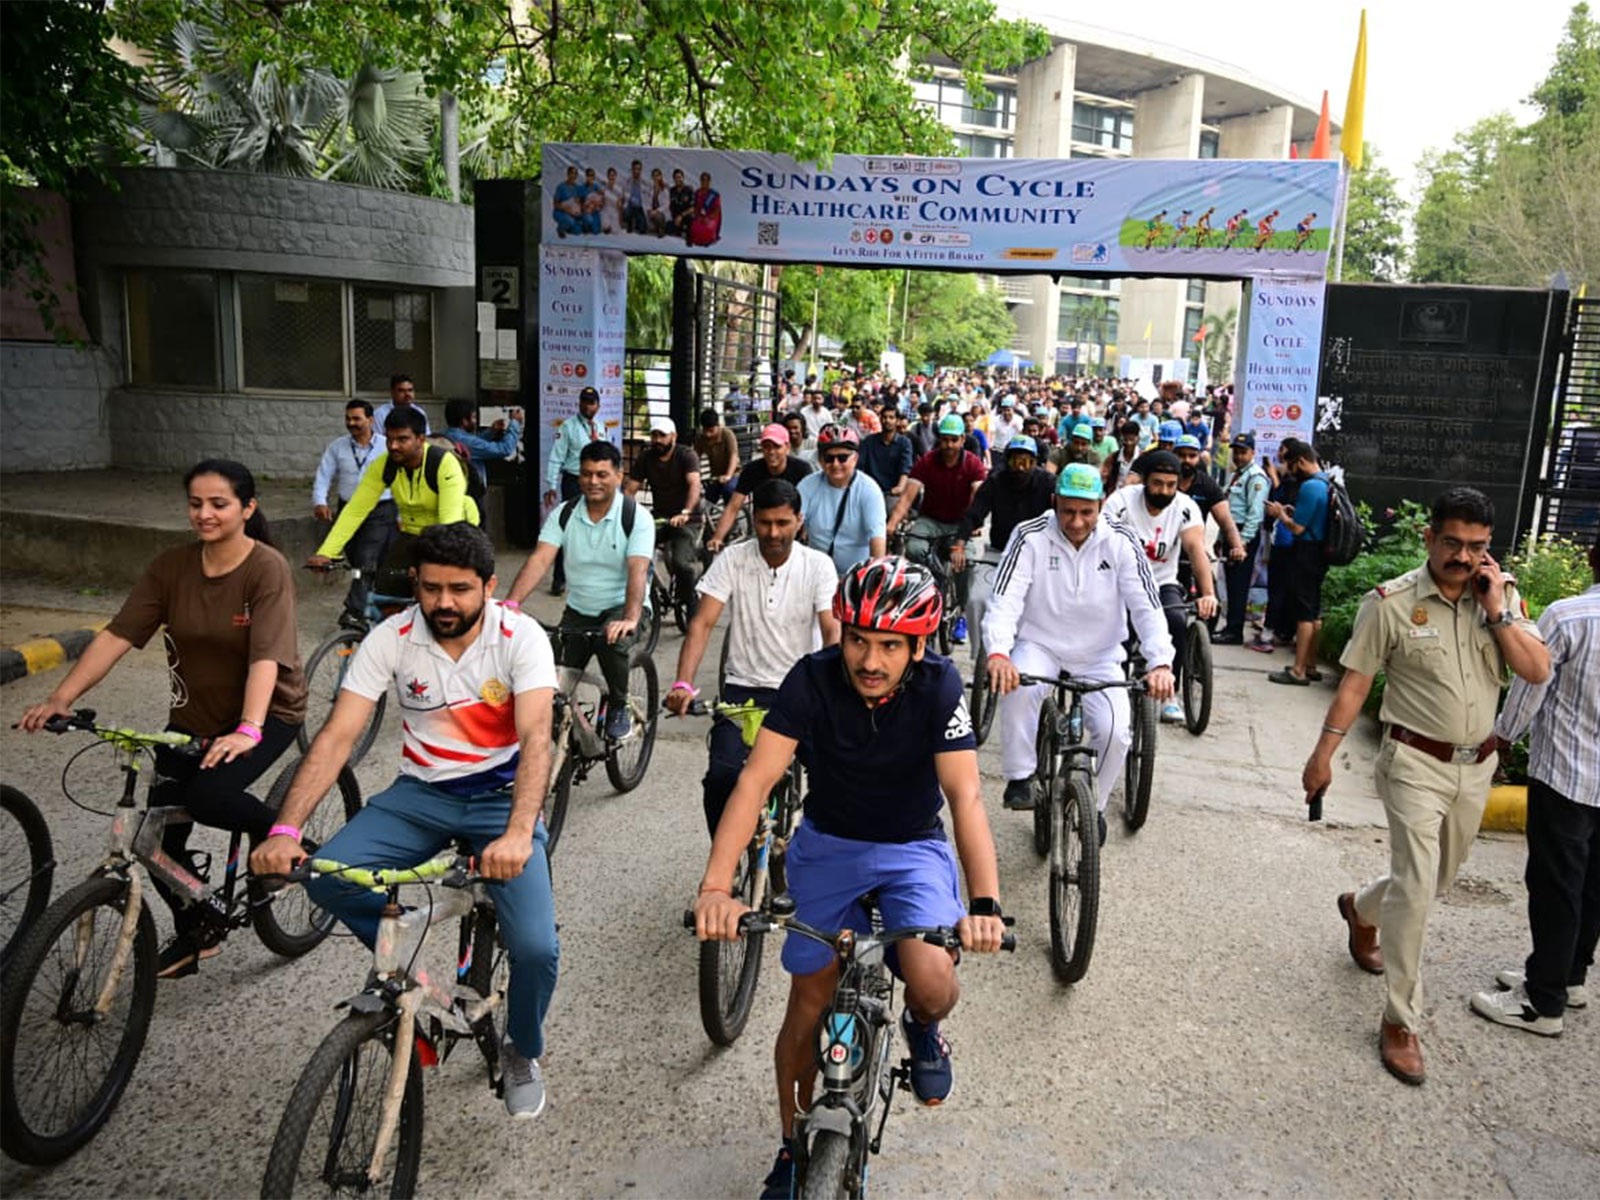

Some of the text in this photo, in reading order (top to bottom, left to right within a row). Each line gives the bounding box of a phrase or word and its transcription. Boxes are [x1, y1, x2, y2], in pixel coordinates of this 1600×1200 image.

[741, 166, 1095, 198] SUNDAYS ON CYCLE
[894, 195, 918, 203] WITH
[751, 194, 1083, 224] HEALTHCARE COMMUNITY
[858, 246, 879, 257] RIDE
[883, 248, 901, 259] FOR
[905, 249, 912, 259] A
[914, 250, 945, 260] FITTER
[545, 263, 592, 277] SUNDAYS
[491, 279, 510, 303] 2
[561, 285, 575, 294] ON
[1258, 292, 1316, 307] SUNDAYS
[552, 300, 582, 314] CYCLE
[1276, 316, 1294, 327] ON
[542, 326, 593, 339] HEALTHCARE
[542, 341, 592, 355] COMMUNITY
[1263, 334, 1304, 348] CYCLE
[1248, 362, 1312, 377] HEALTHCARE
[1247, 381, 1308, 394] COMMUNITY
